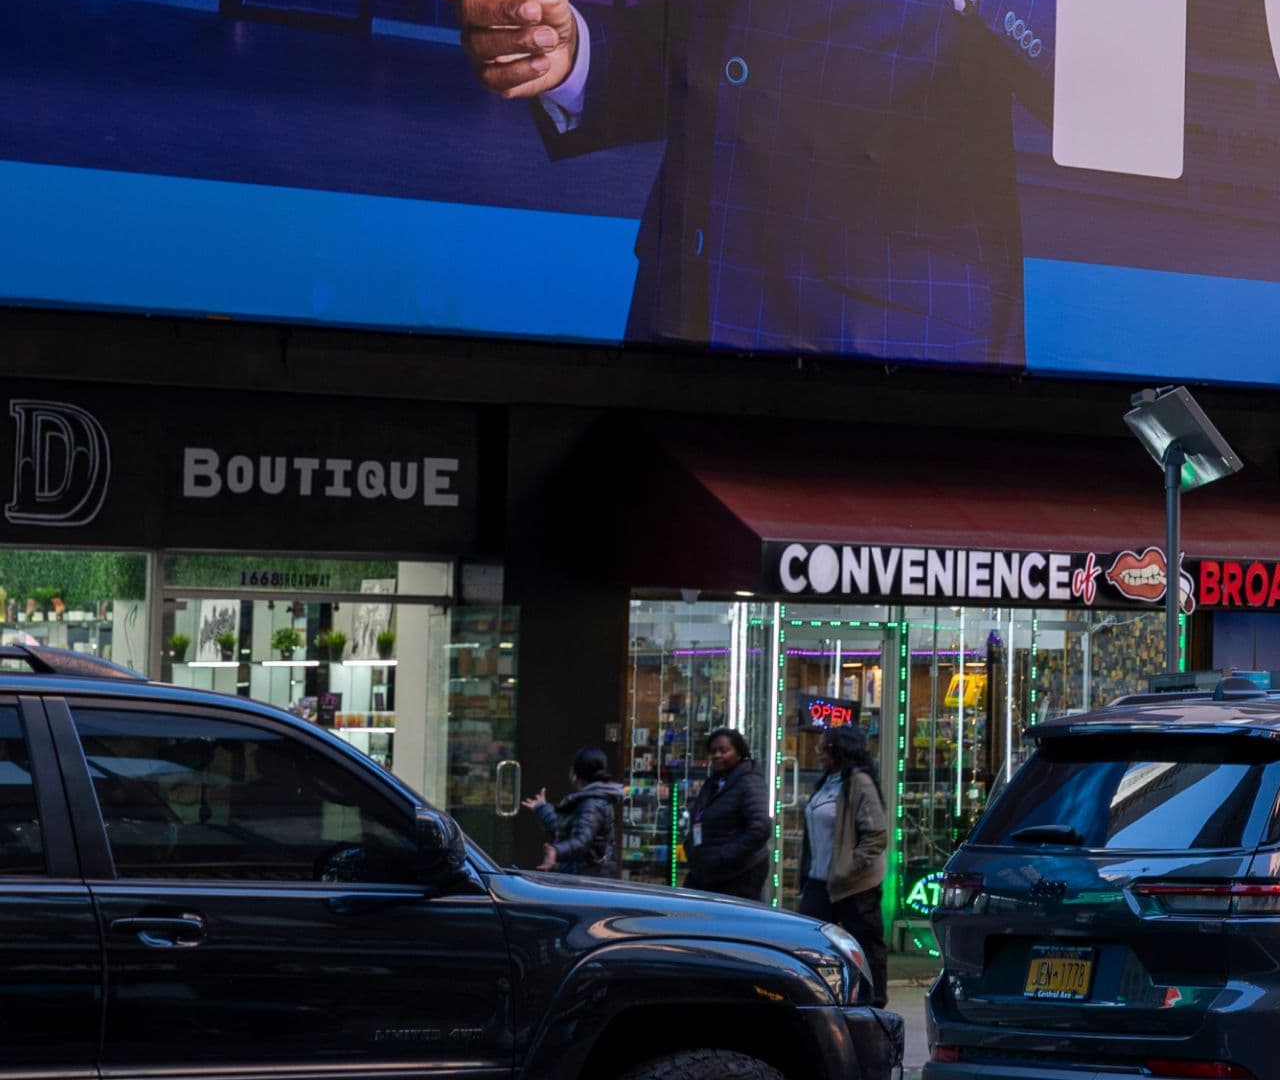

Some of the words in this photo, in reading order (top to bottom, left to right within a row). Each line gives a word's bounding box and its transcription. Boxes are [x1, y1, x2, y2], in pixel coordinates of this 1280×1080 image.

[780, 543, 1072, 601] CONVENIENCE
[1072, 552, 1100, 605] of
[810, 704, 852, 722] OPEN
[906, 881, 942, 907] AT
